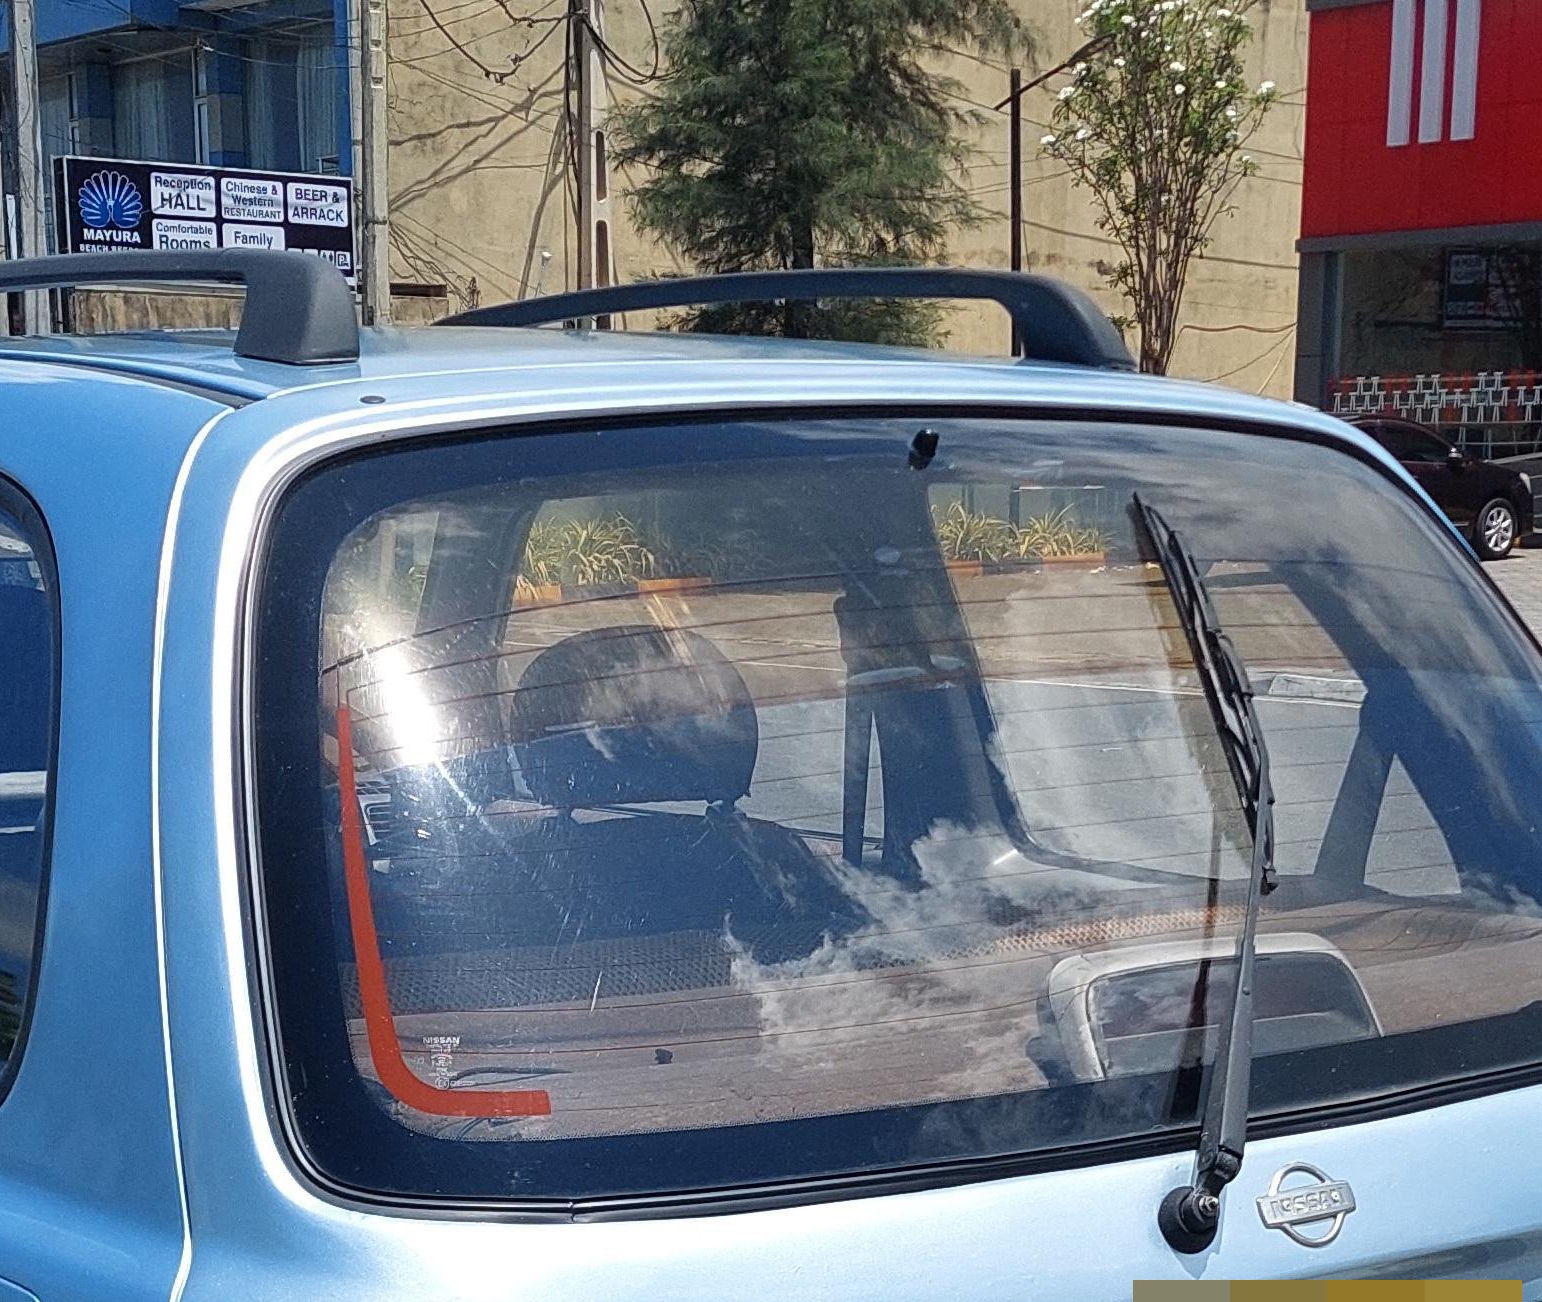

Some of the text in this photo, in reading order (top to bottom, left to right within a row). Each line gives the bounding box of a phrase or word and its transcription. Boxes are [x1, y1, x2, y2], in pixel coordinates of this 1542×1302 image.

[154, 175, 212, 191] Reception
[225, 181, 278, 195] Chinese &
[160, 191, 207, 211] HALL
[231, 194, 274, 207] Western
[295, 188, 340, 203] BEER &
[223, 206, 281, 220] RESTAURANT
[291, 206, 345, 222] ARRACK
[83, 228, 141, 243] MAYURA
[155, 221, 213, 236] Comfortable
[159, 234, 211, 250] Rooms
[234, 230, 273, 249] Family
[422, 1036, 460, 1045] NISSAN
[1270, 1187, 1346, 1218] NISSAN
